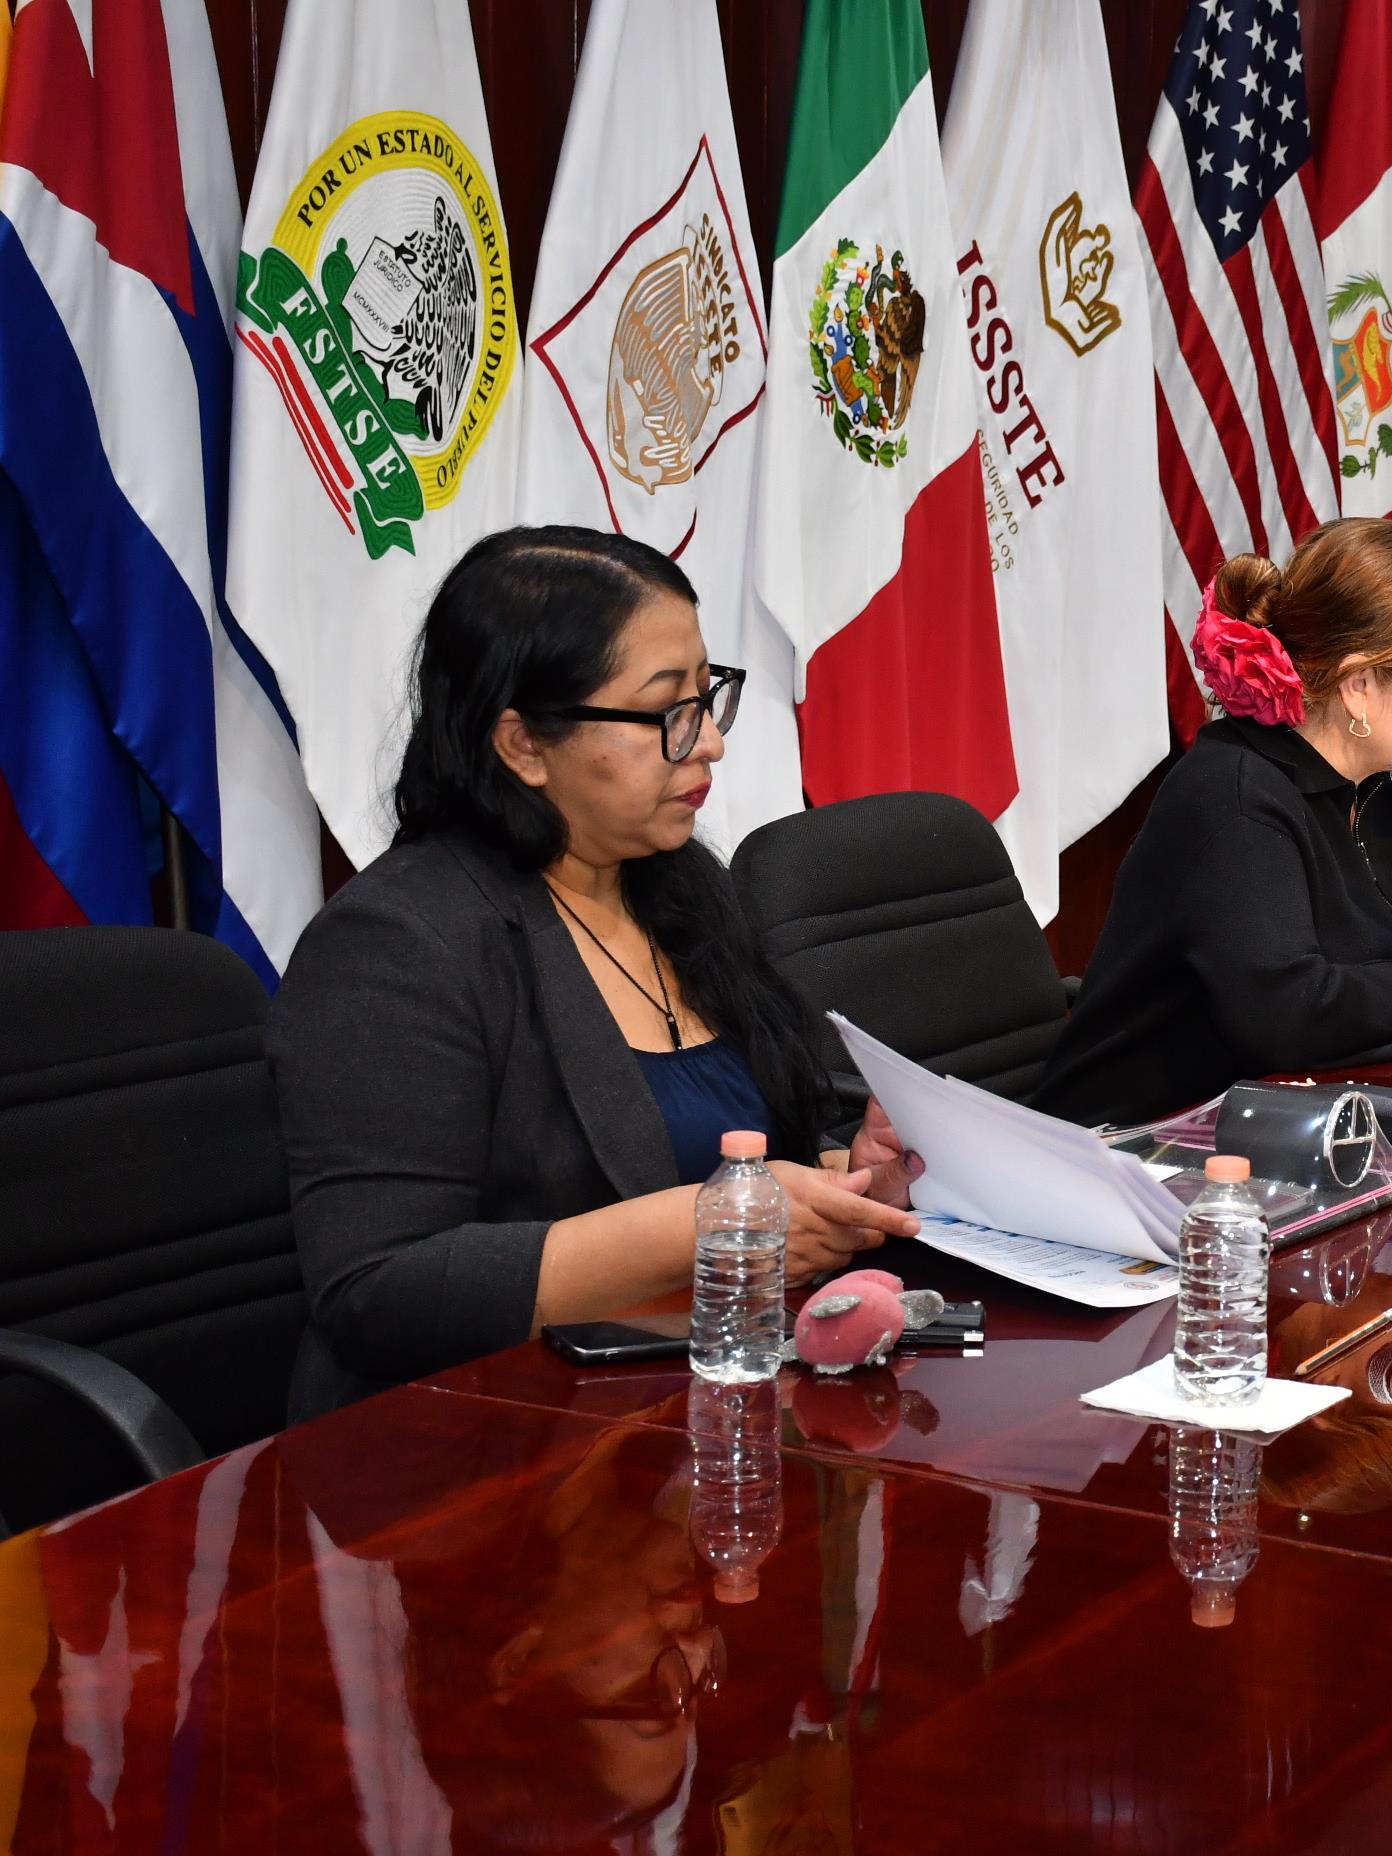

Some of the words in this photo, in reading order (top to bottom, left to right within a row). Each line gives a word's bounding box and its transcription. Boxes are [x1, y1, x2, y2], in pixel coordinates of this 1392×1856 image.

[339, 139, 373, 175] UN
[376, 129, 454, 168] ESTADO
[297, 169, 342, 228] POR
[454, 162, 473, 198] AL
[379, 250, 412, 287] ESTATUTO
[472, 195, 507, 342] SERVICIO
[700, 213, 741, 363] SINDICATO
[280, 287, 407, 490] FSTSE
[473, 349, 502, 405] DEL
[956, 239, 1065, 510] ISSSTE
[985, 501, 998, 527] DE
[995, 532, 1015, 570] LOS
